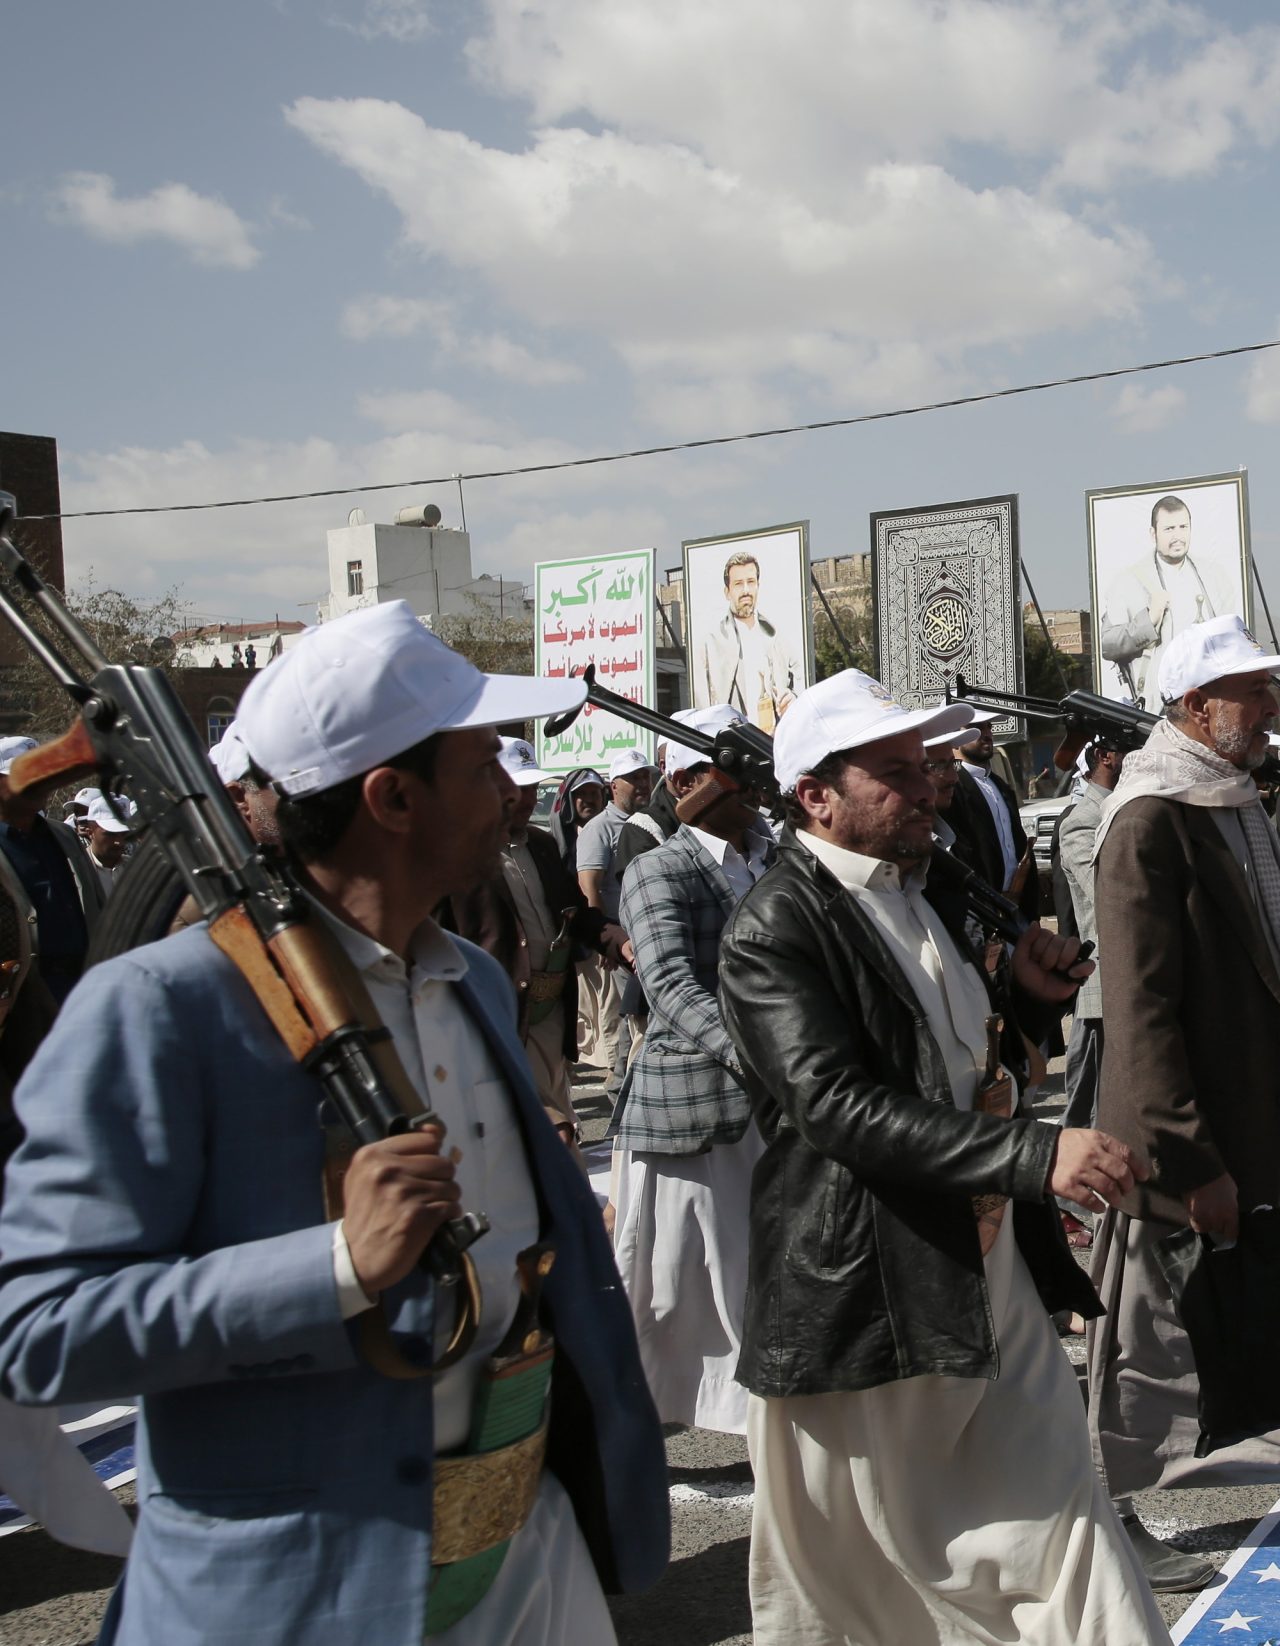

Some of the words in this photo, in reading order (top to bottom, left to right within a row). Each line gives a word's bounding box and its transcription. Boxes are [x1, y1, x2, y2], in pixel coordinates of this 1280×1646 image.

[543, 566, 604, 618] أكبر
[543, 613, 595, 646] لأمريكا
[600, 612, 642, 642] الموت
[600, 649, 643, 678] الموت
[597, 720, 643, 758] النصر
